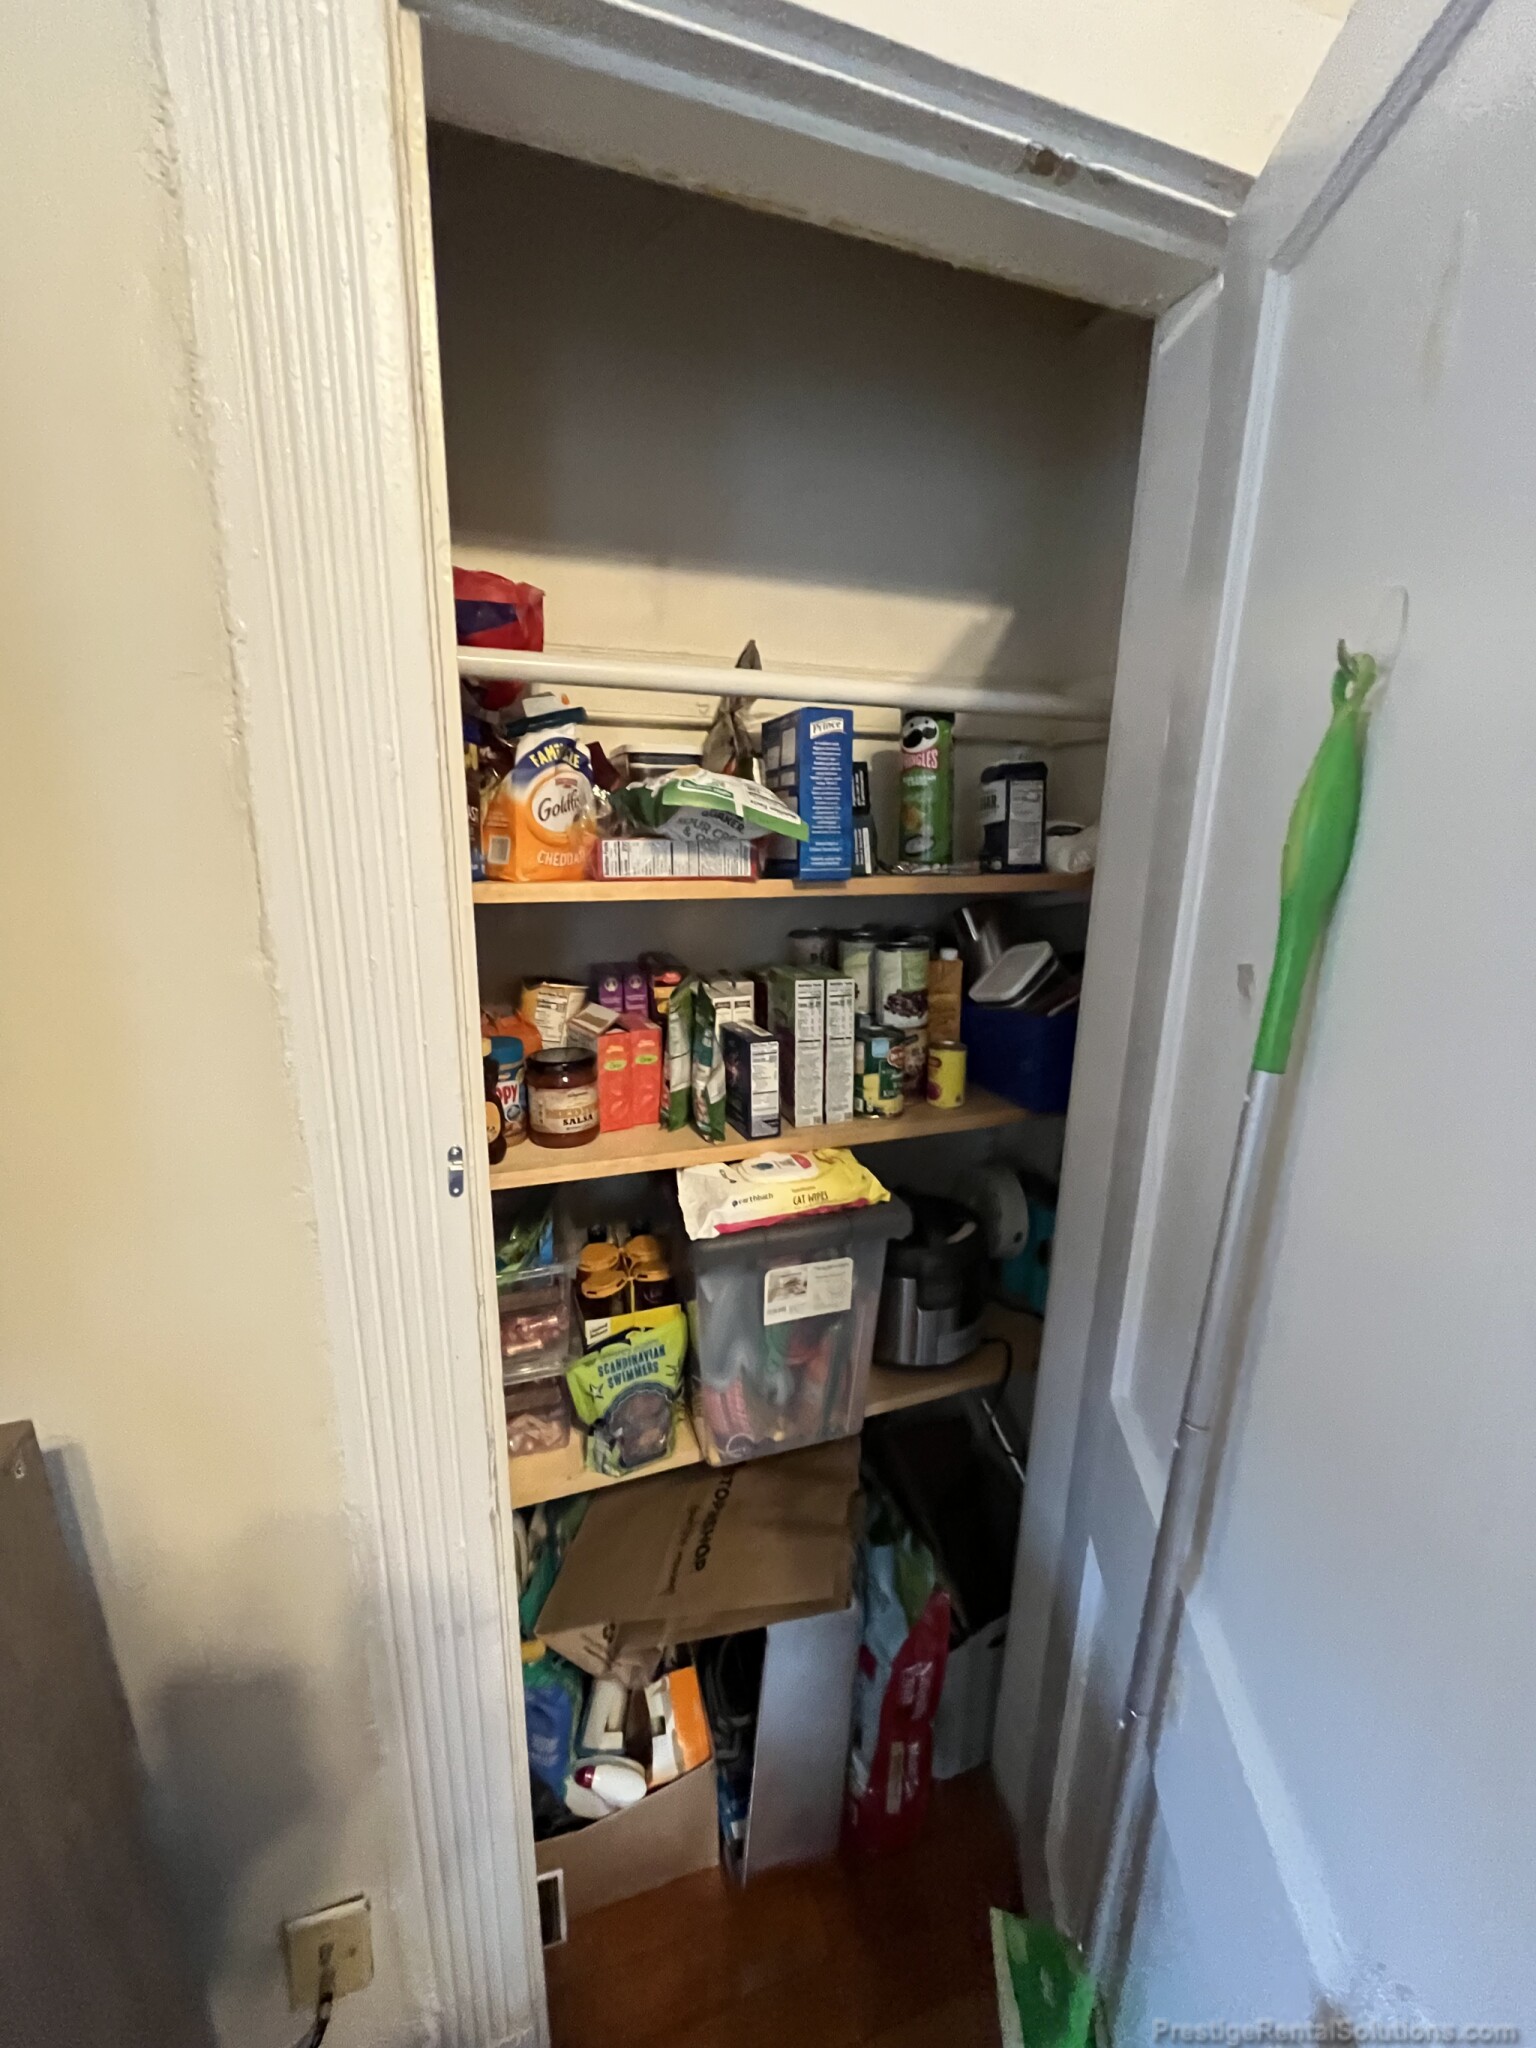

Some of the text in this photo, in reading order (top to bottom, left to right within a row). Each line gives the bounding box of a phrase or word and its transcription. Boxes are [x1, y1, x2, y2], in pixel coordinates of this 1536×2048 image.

[562, 1112, 594, 1127] SALSA
[792, 1191, 829, 1205] CAT WIPES
[597, 1344, 667, 1377] SCANDINAVIAN
[607, 1362, 660, 1389] SWIMMERS
